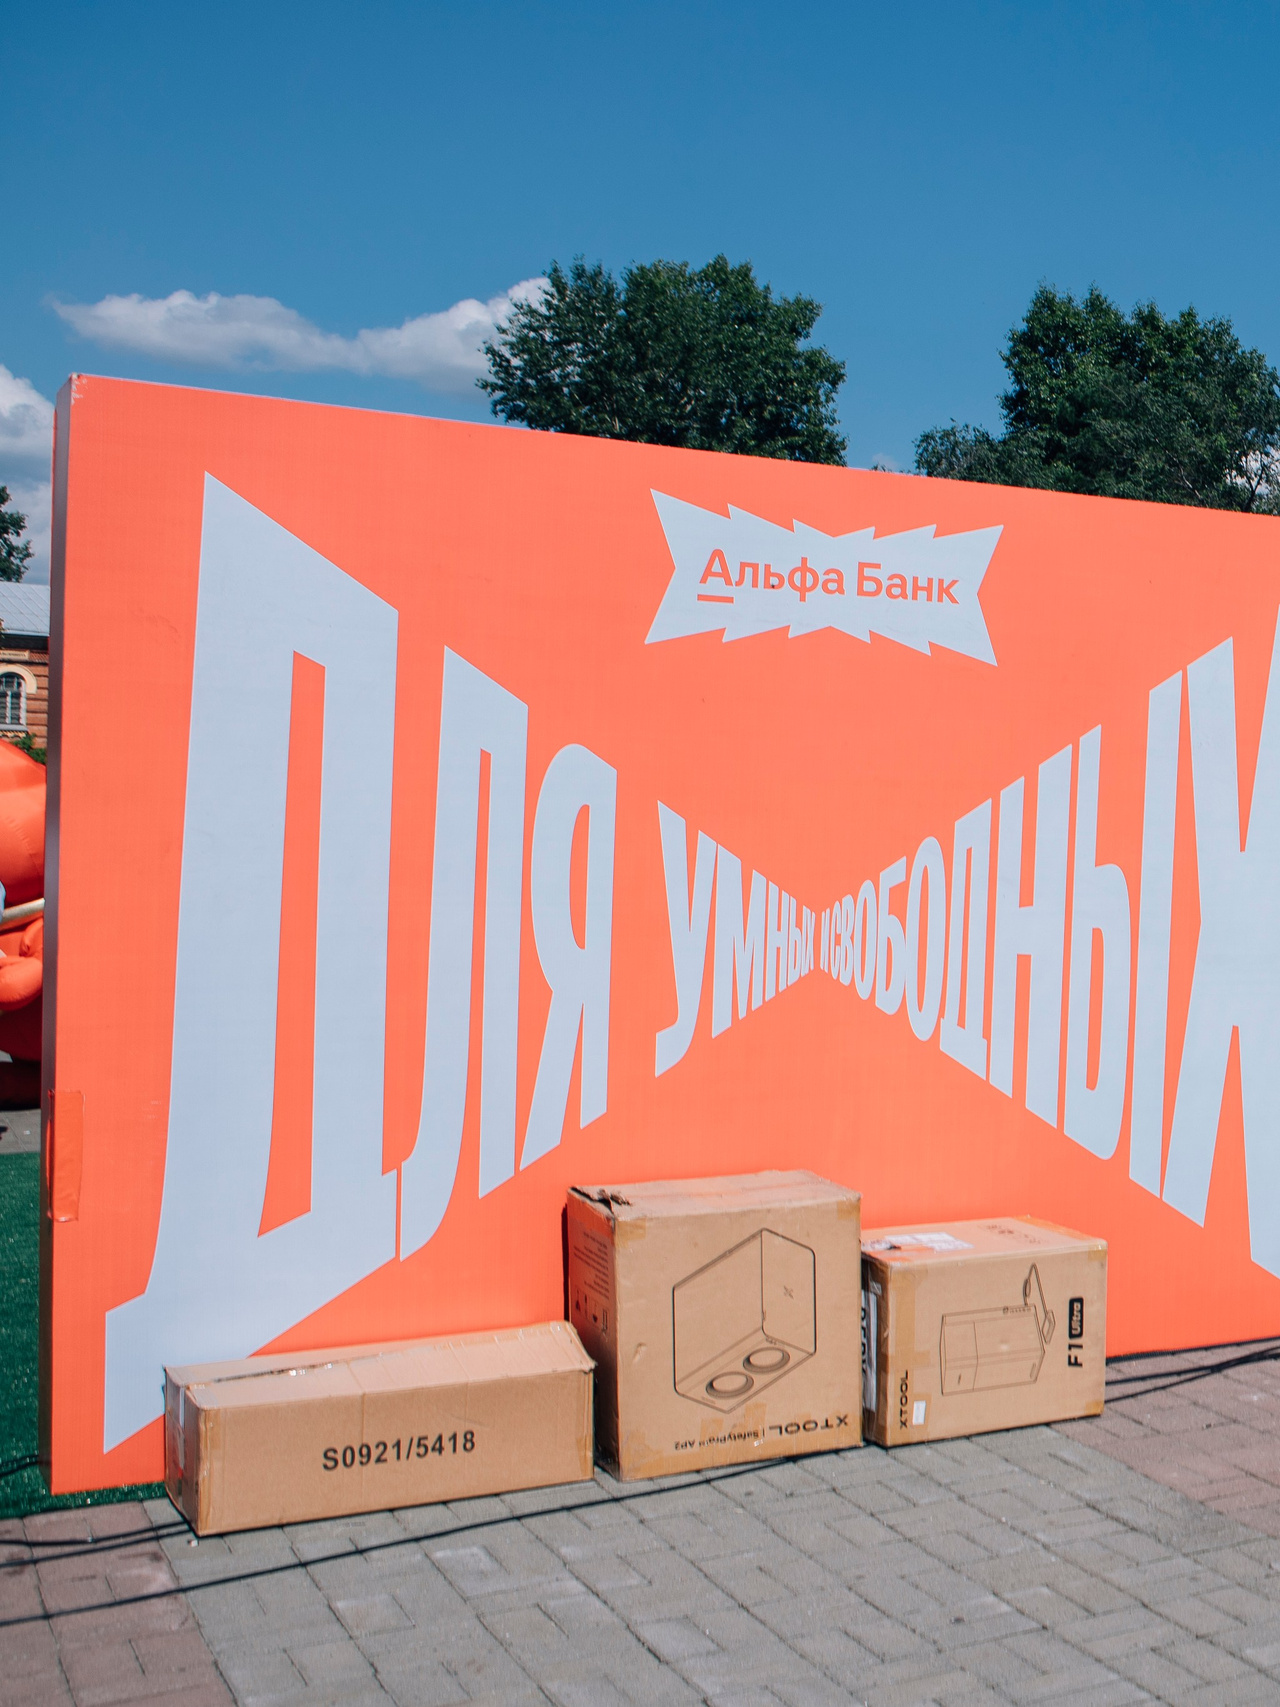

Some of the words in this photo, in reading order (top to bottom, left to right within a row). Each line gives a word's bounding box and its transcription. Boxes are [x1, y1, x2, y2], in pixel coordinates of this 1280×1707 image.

[697, 547, 846, 604] Альфа
[856, 561, 960, 605] Банк
[103, 471, 618, 1456] ДЛЯ
[655, 799, 816, 1078] УМНЫХ
[1070, 1301, 1082, 1335] Ultra
[1067, 1343, 1083, 1368] F1
[899, 1369, 909, 1430] XTOOL
[674, 1438, 696, 1451] AP2
[768, 1414, 849, 1437] XTOOL
[322, 1429, 476, 1472] S0921/5418
